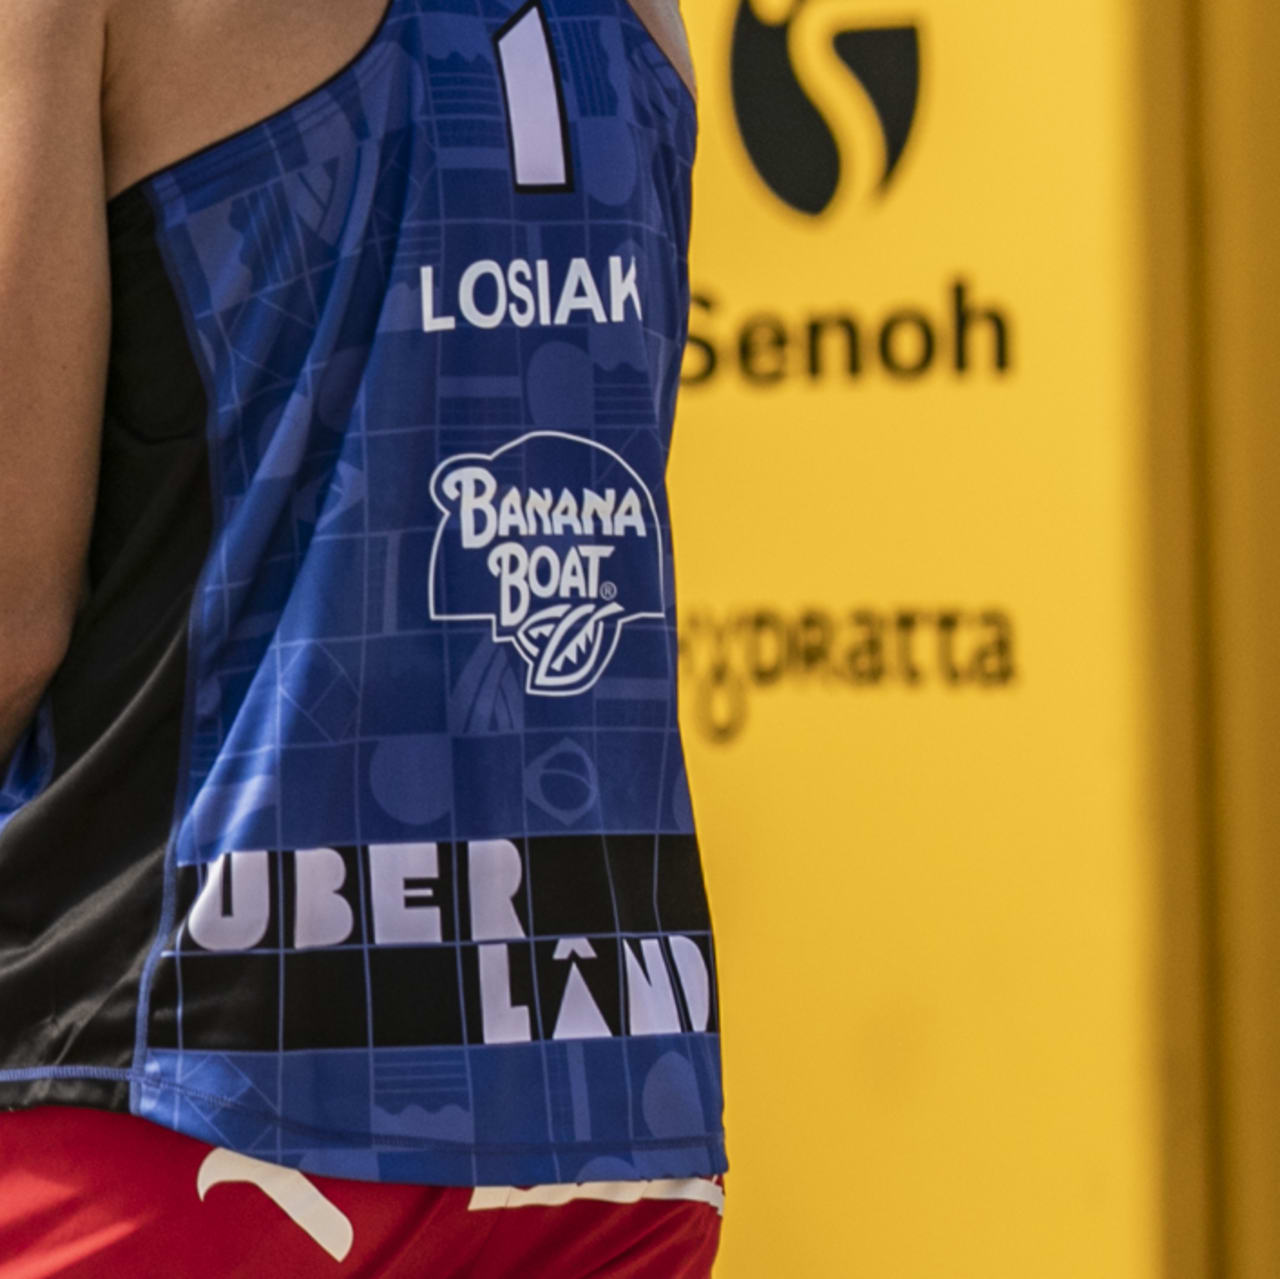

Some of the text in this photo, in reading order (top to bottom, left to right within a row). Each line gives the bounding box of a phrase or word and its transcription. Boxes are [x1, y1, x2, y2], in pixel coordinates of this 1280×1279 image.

[420, 255, 643, 332] LOSIAK
[680, 274, 1010, 386] Senoh
[441, 466, 647, 549] BANANA
[487, 542, 616, 627] BOAT
[188, 838, 527, 953] UBER
